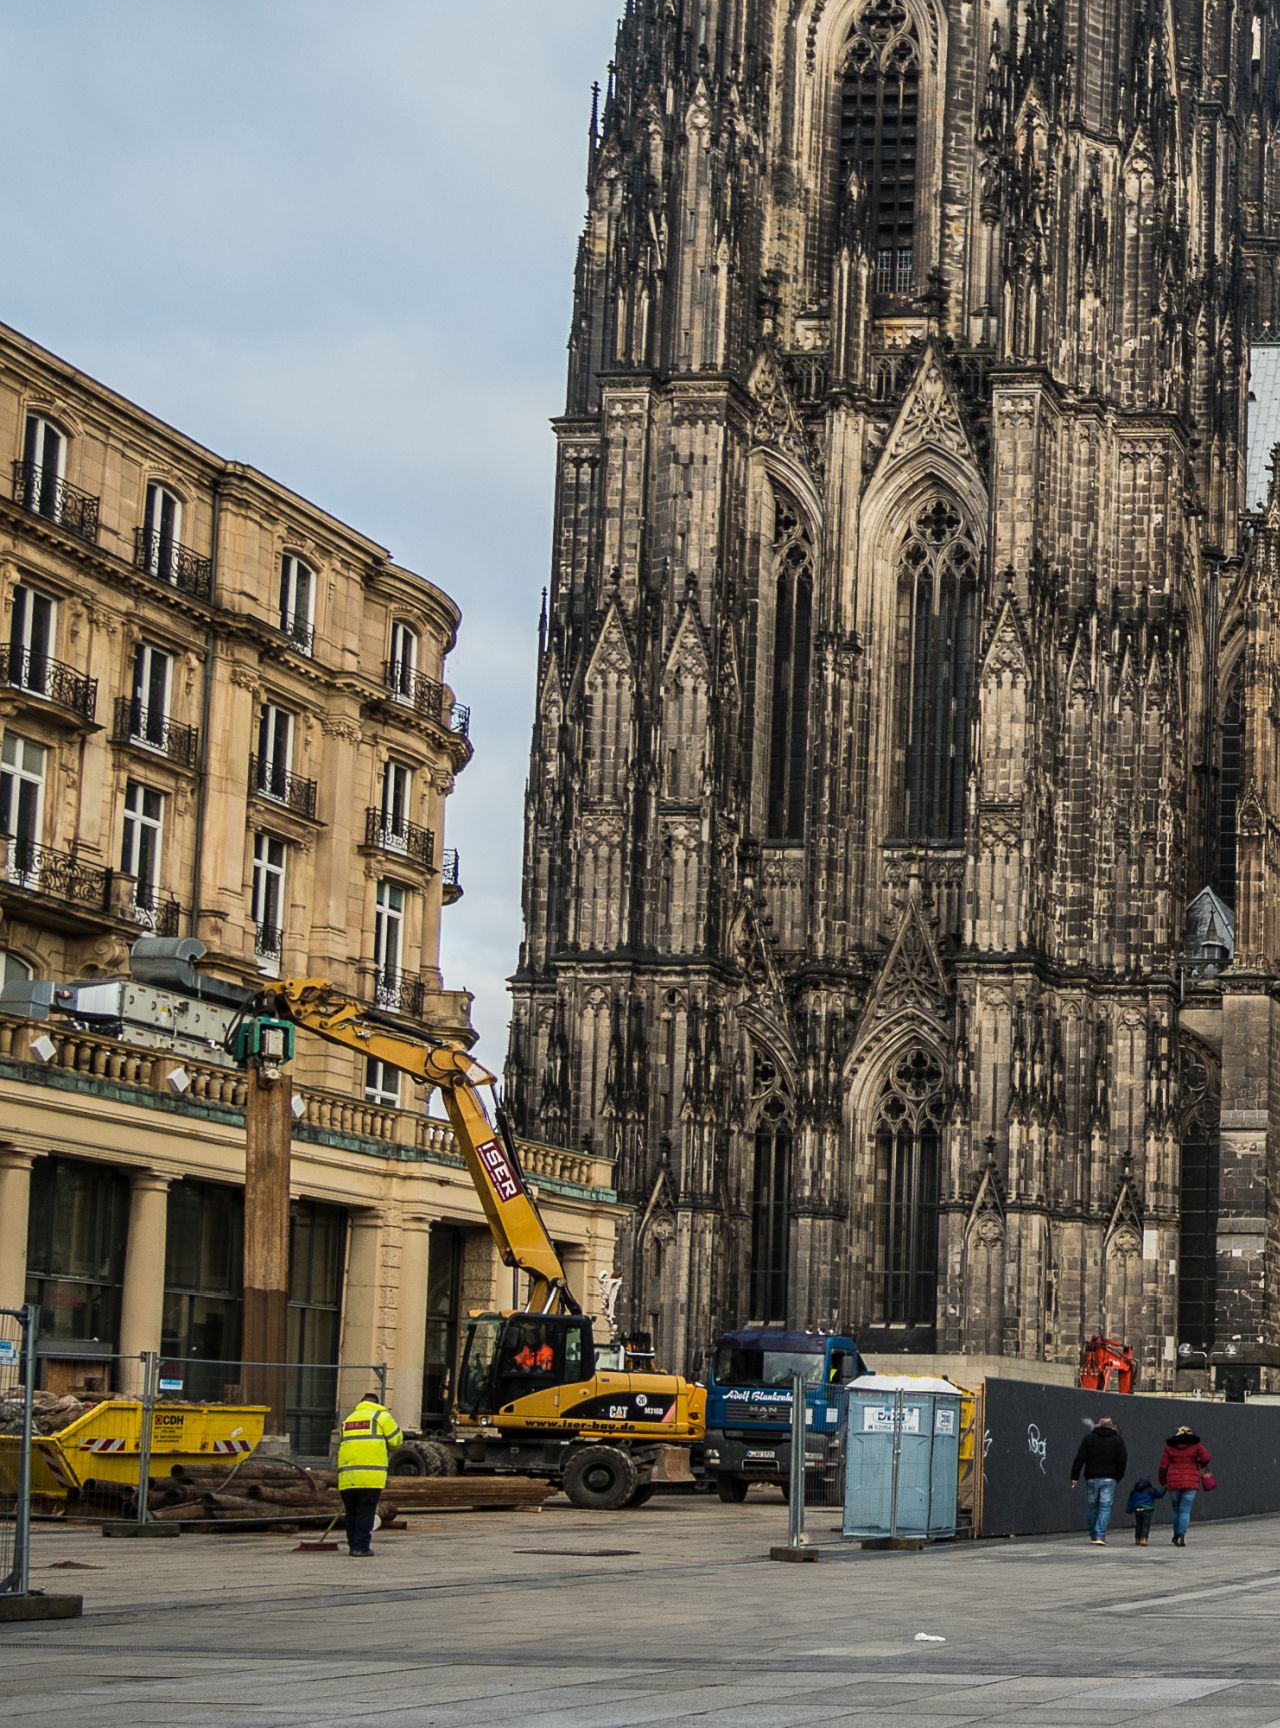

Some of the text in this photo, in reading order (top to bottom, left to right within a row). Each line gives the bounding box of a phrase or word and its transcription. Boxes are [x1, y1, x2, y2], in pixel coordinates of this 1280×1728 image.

[482, 1141, 517, 1198] ISER
[638, 1395, 645, 1404] 20
[722, 1389, 794, 1402] Adolf Blankenhe
[609, 1405, 628, 1419] CAT
[163, 1415, 184, 1425] CDH
[525, 1419, 636, 1431] www.iser-bau.de
